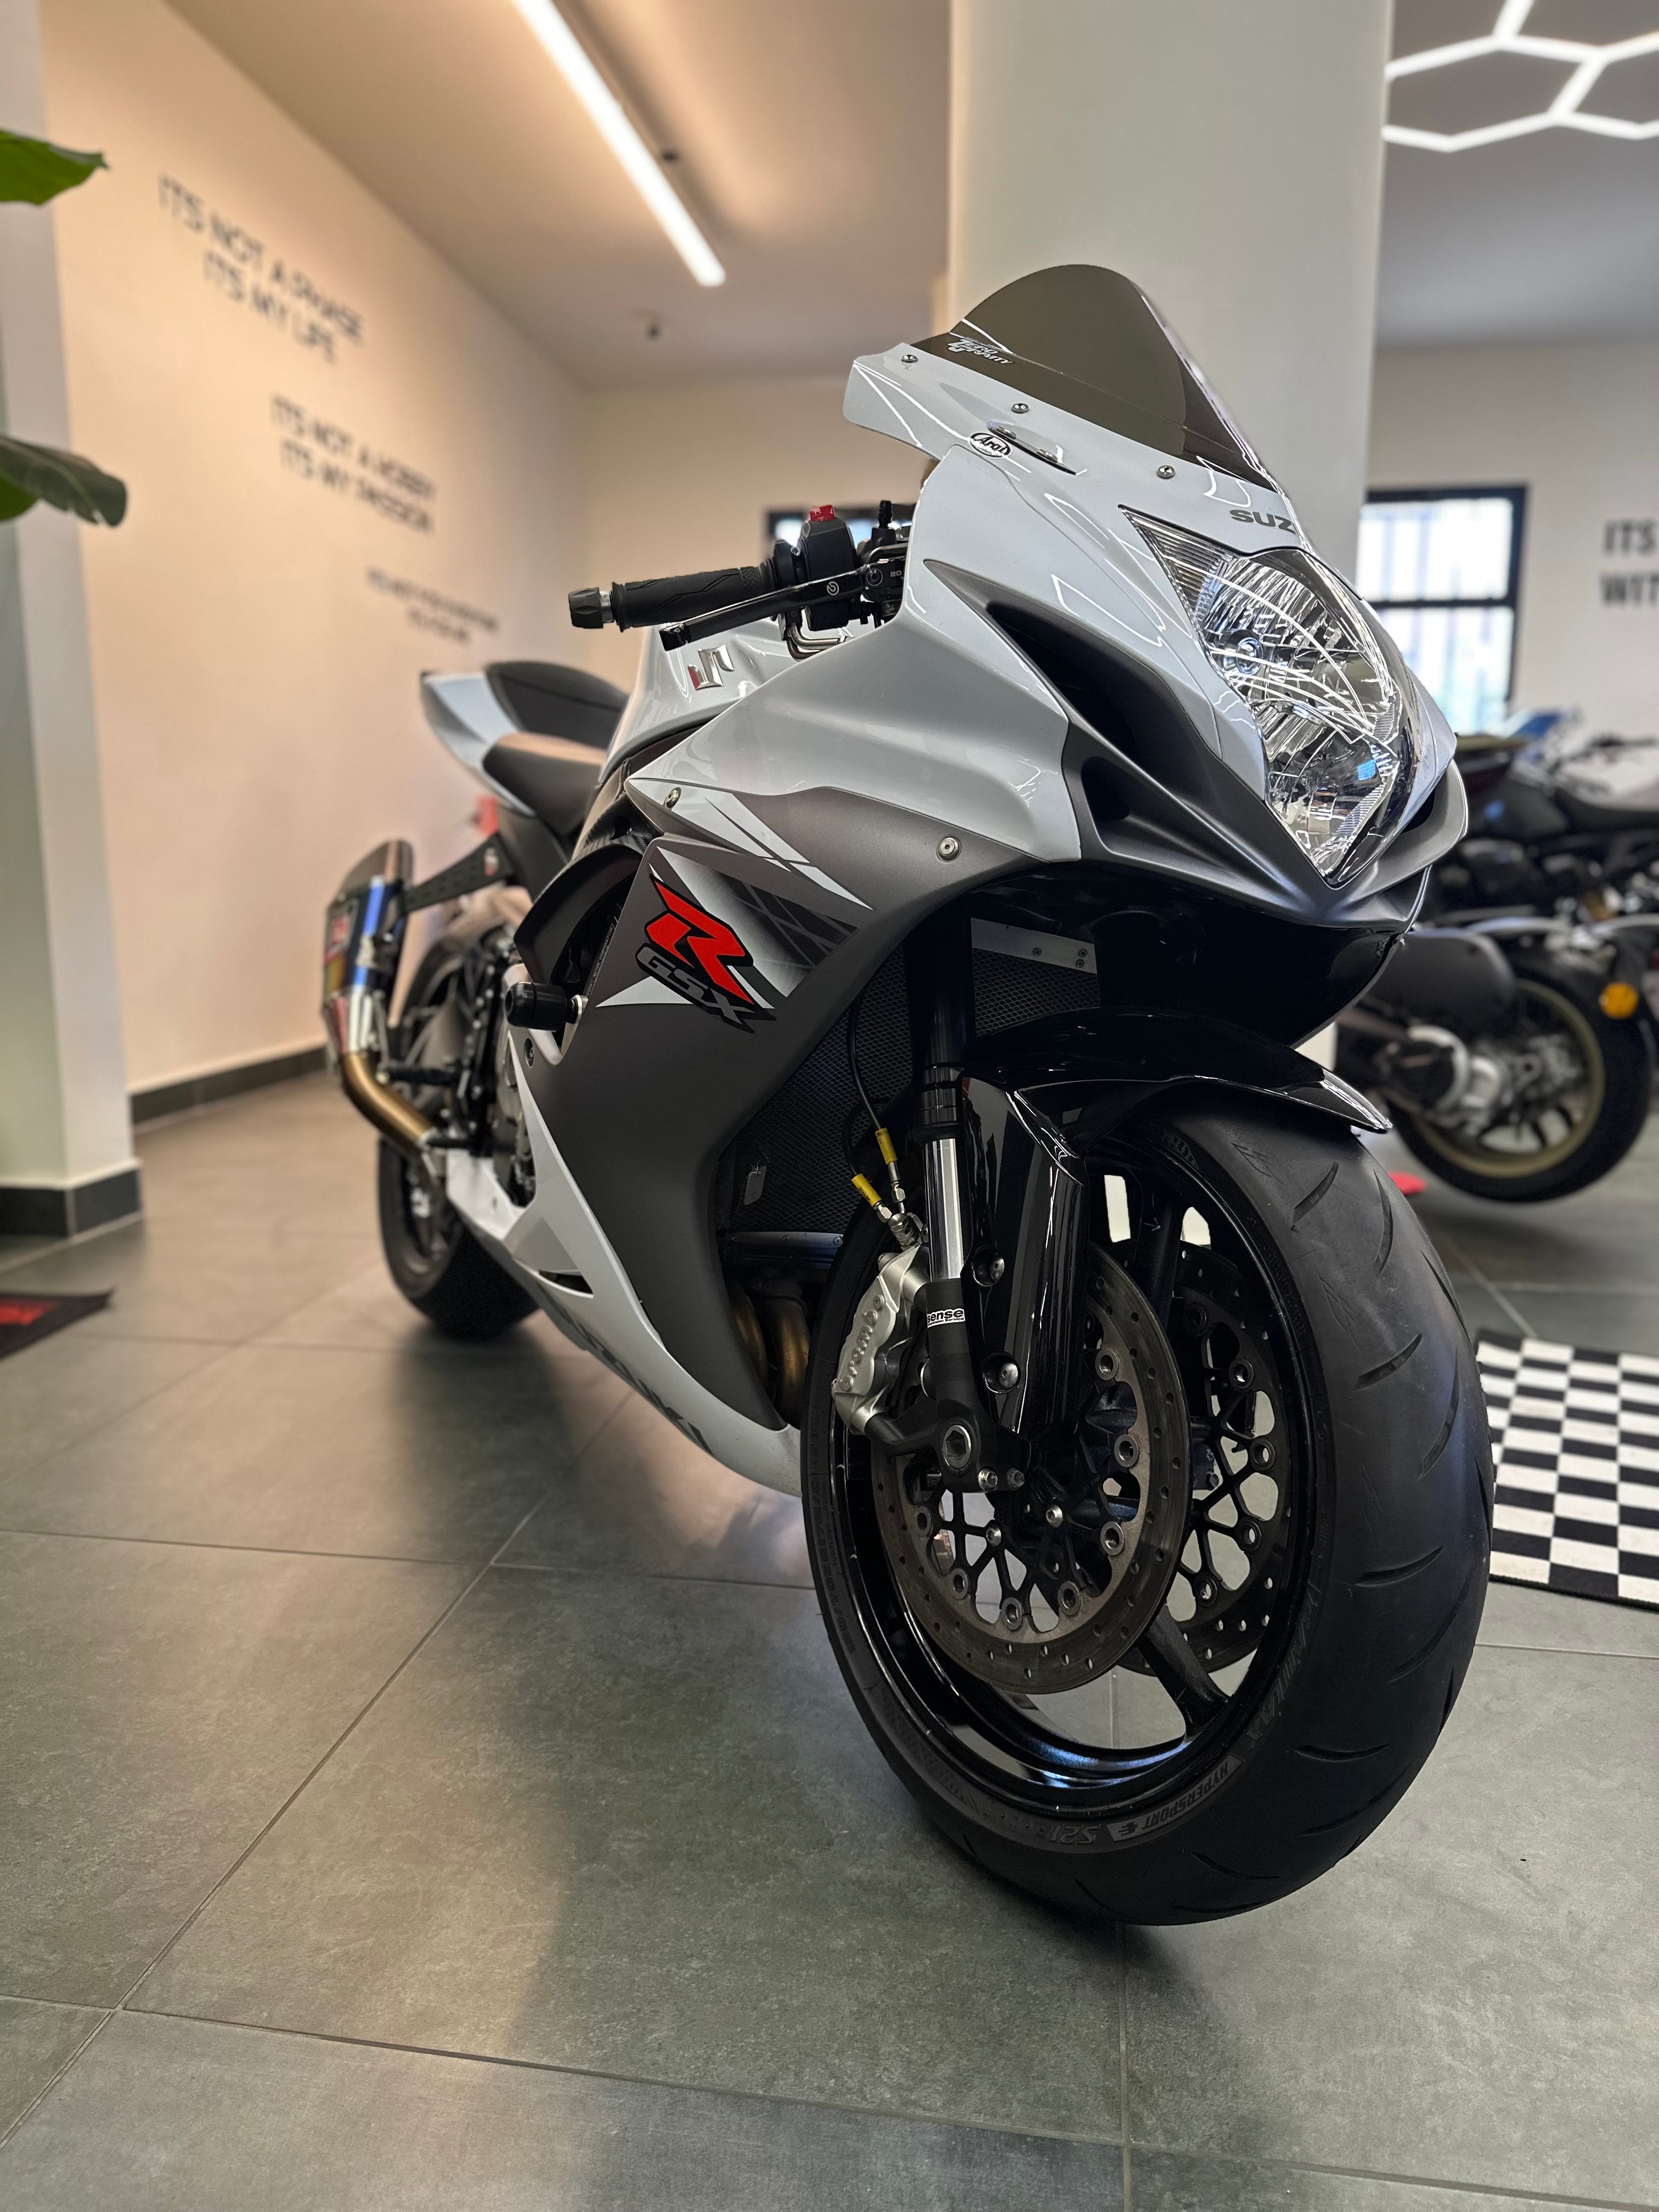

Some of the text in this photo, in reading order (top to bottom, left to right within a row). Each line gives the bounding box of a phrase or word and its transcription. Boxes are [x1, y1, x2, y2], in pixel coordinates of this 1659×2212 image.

[976, 435, 1009, 454] Arai
[1229, 510, 1296, 535] SUZ
[839, 1294, 885, 1392] brembo
[1144, 1761, 1229, 1829] HYPERSPORT
